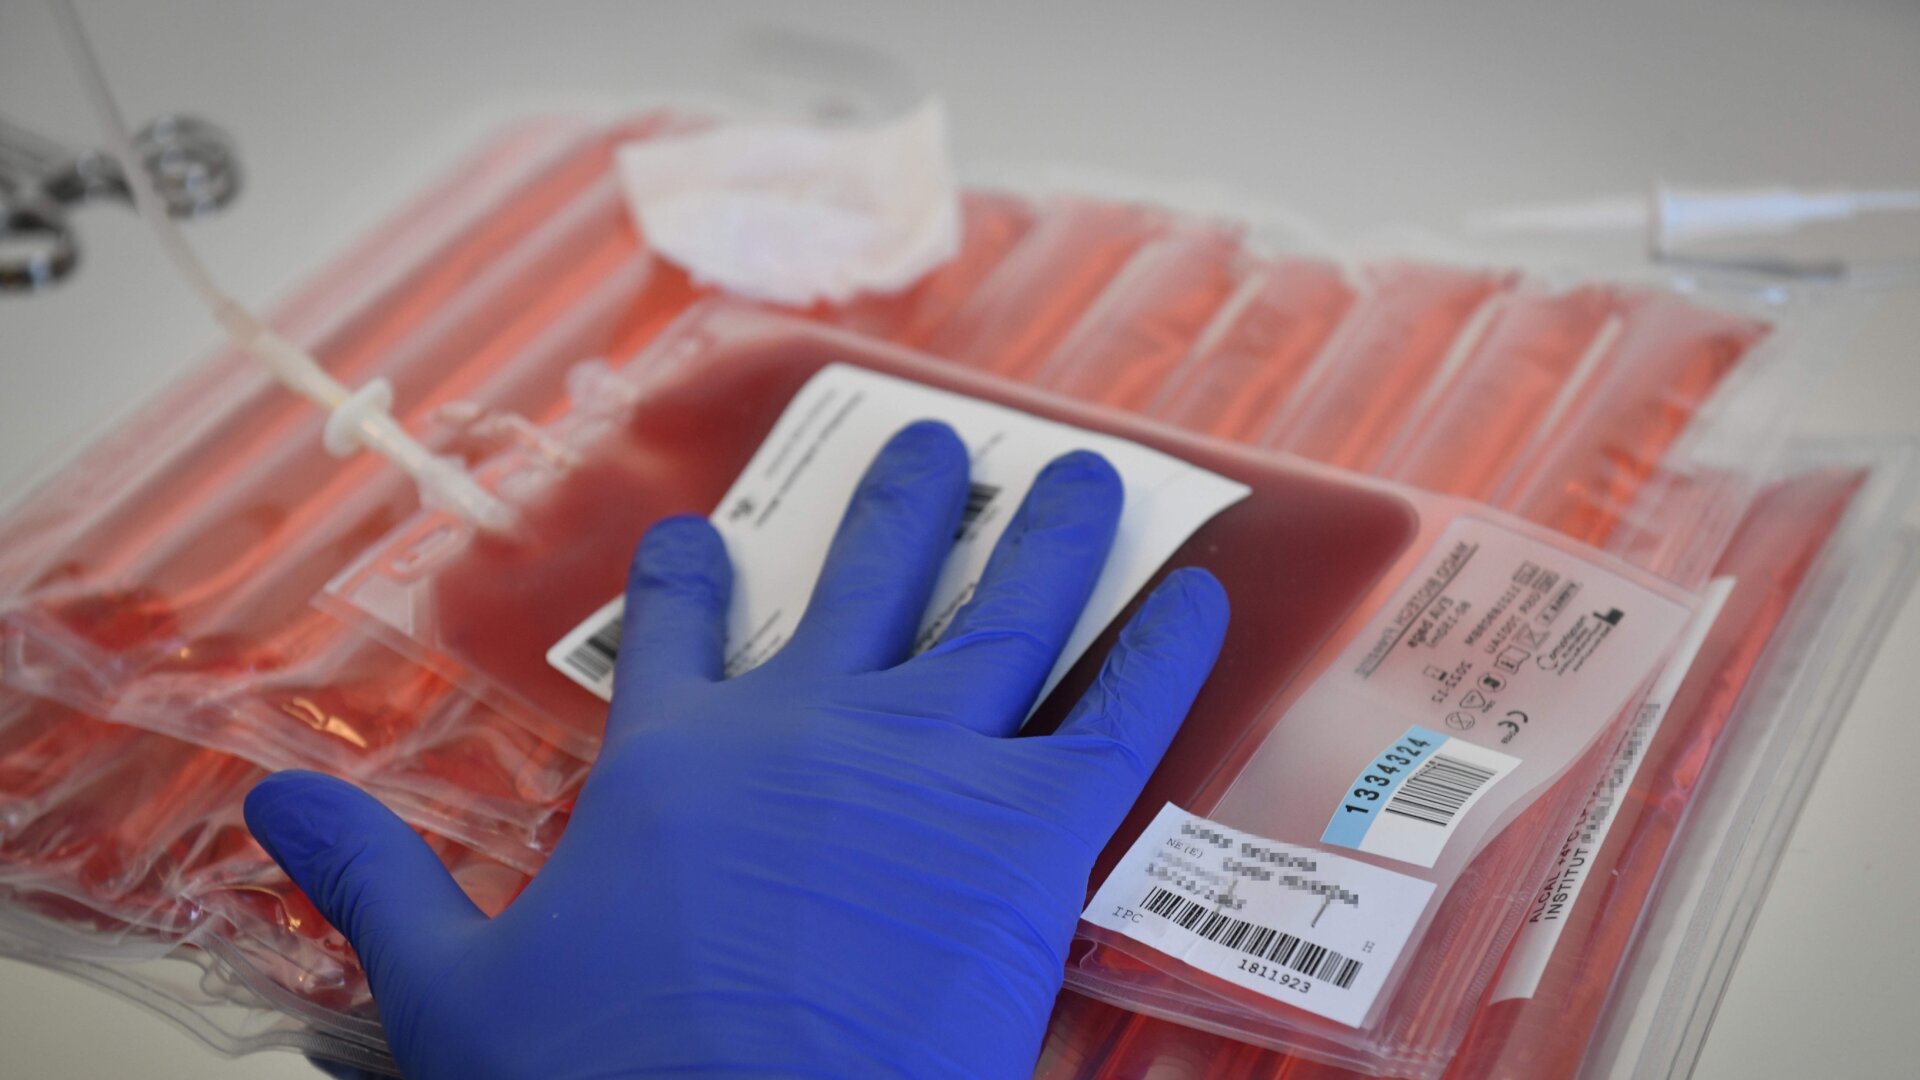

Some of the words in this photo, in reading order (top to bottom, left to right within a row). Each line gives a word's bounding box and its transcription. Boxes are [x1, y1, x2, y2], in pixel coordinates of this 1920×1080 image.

[1345, 737, 1431, 813] 1334324
[1529, 871, 1560, 923] ALCAL
[1545, 848, 1588, 920] INSTITUT
[1112, 906, 1144, 924] IPC
[1237, 958, 1313, 994] 1811923
